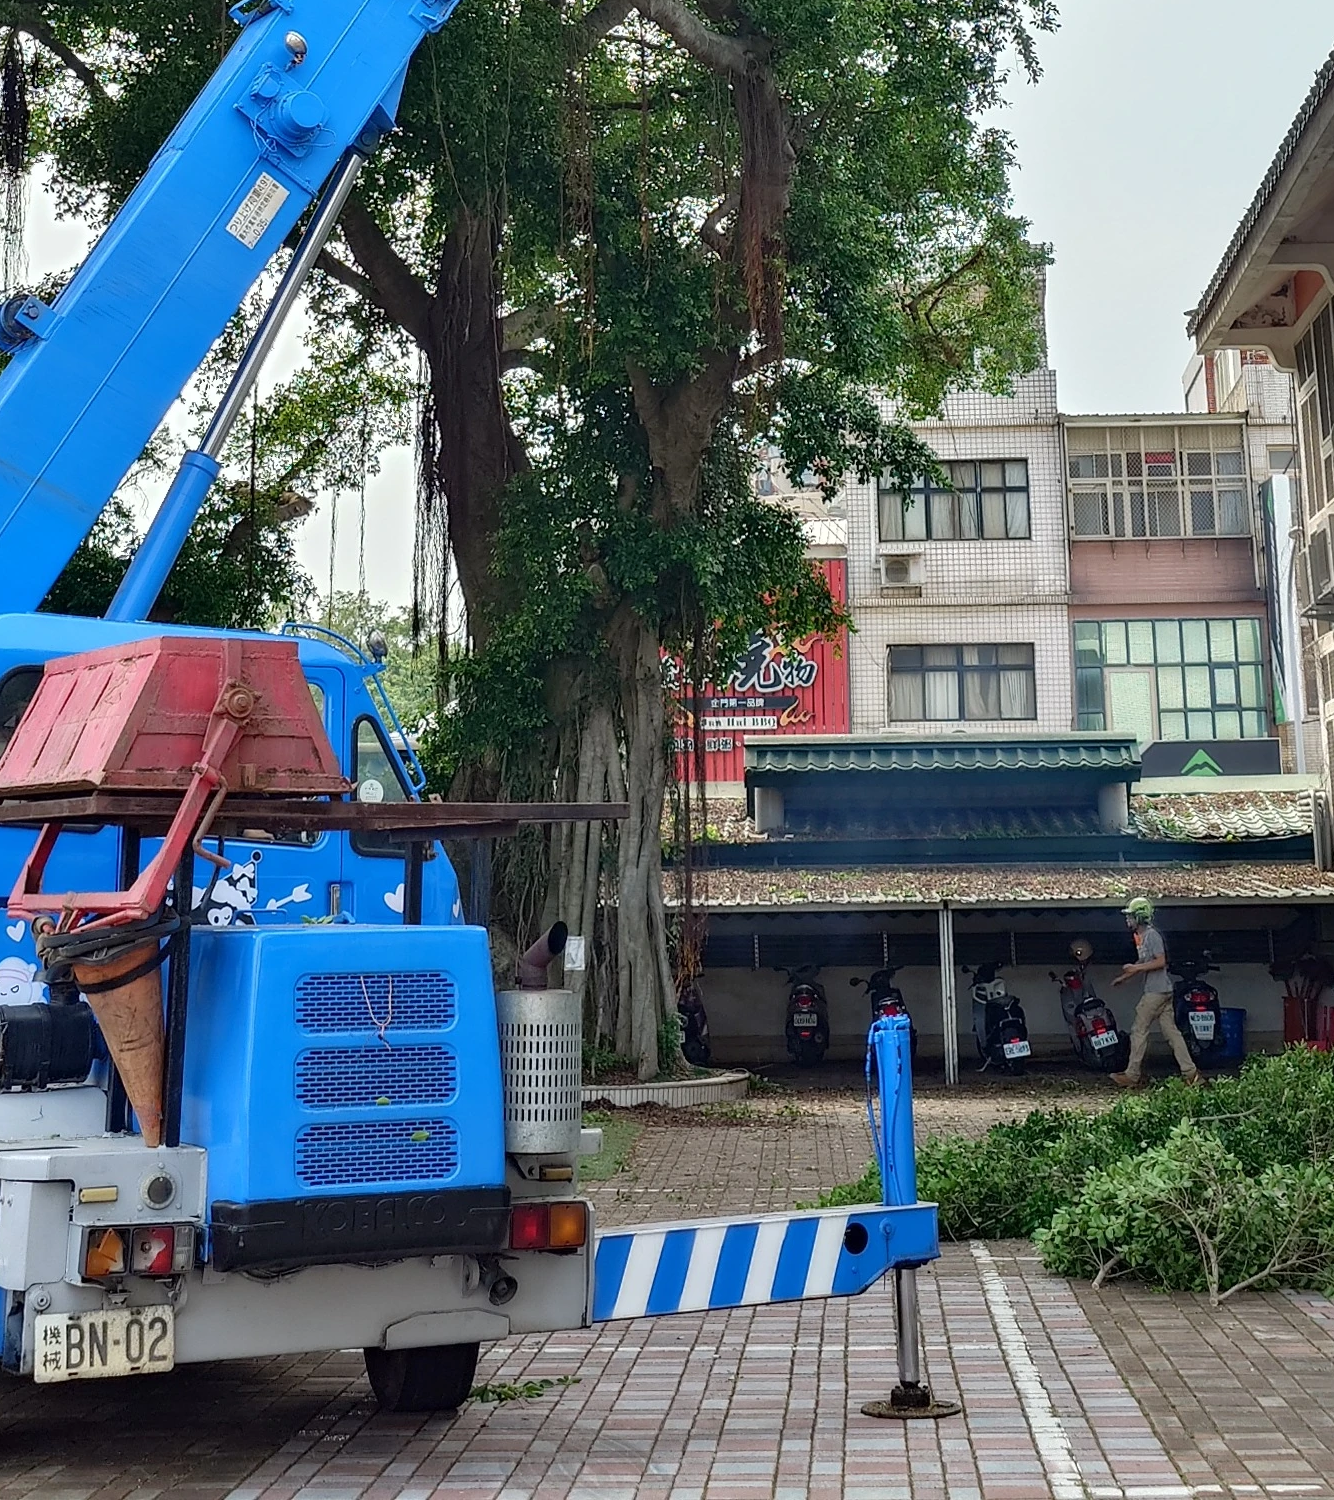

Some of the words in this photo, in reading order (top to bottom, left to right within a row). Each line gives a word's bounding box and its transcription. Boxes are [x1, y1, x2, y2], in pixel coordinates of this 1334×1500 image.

[752, 717, 776, 728] BBQ
[301, 1194, 447, 1238] KOBELCO
[42, 1324, 62, 1373] 機械
[65, 1316, 168, 1370] BN-02
